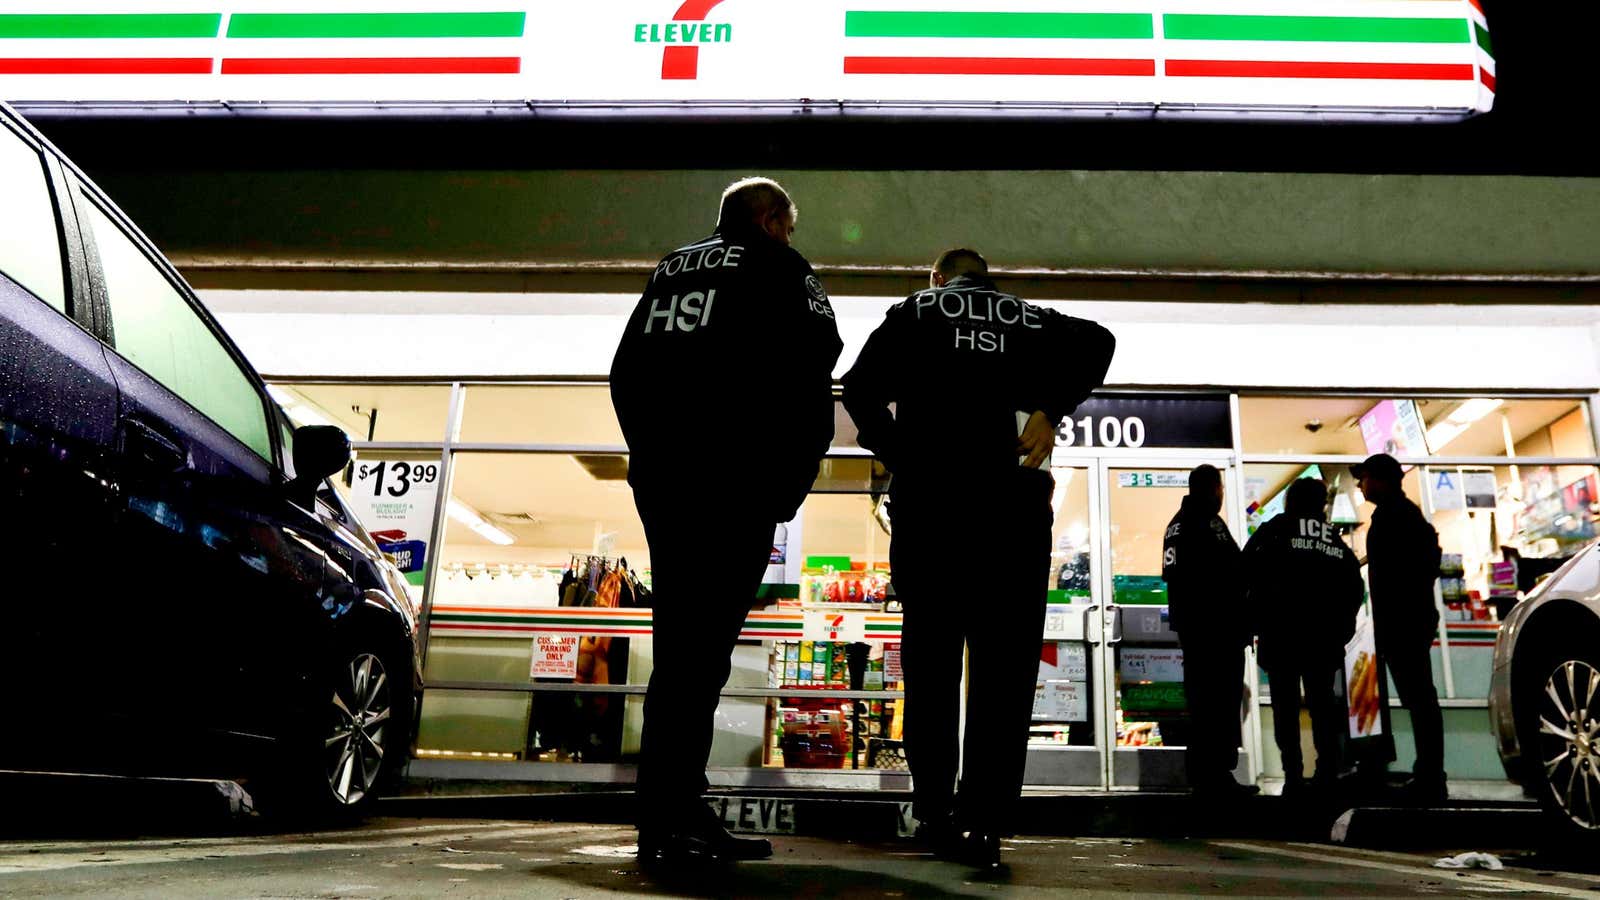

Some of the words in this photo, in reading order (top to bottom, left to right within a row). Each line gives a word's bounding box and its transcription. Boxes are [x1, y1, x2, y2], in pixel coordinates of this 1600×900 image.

[634, 23, 732, 43] ELEVEN
[653, 246, 744, 283] POLICE
[644, 289, 716, 334] HSI
[808, 298, 834, 319] ICE
[916, 292, 1042, 329] POLICE
[955, 328, 1004, 352] HSI
[1055, 416, 1145, 448] 3100
[1437, 472, 1454, 490] A
[1300, 518, 1333, 543] ICE
[1315, 541, 1343, 559] AFFAIRS
[707, 797, 795, 830] LEVE
